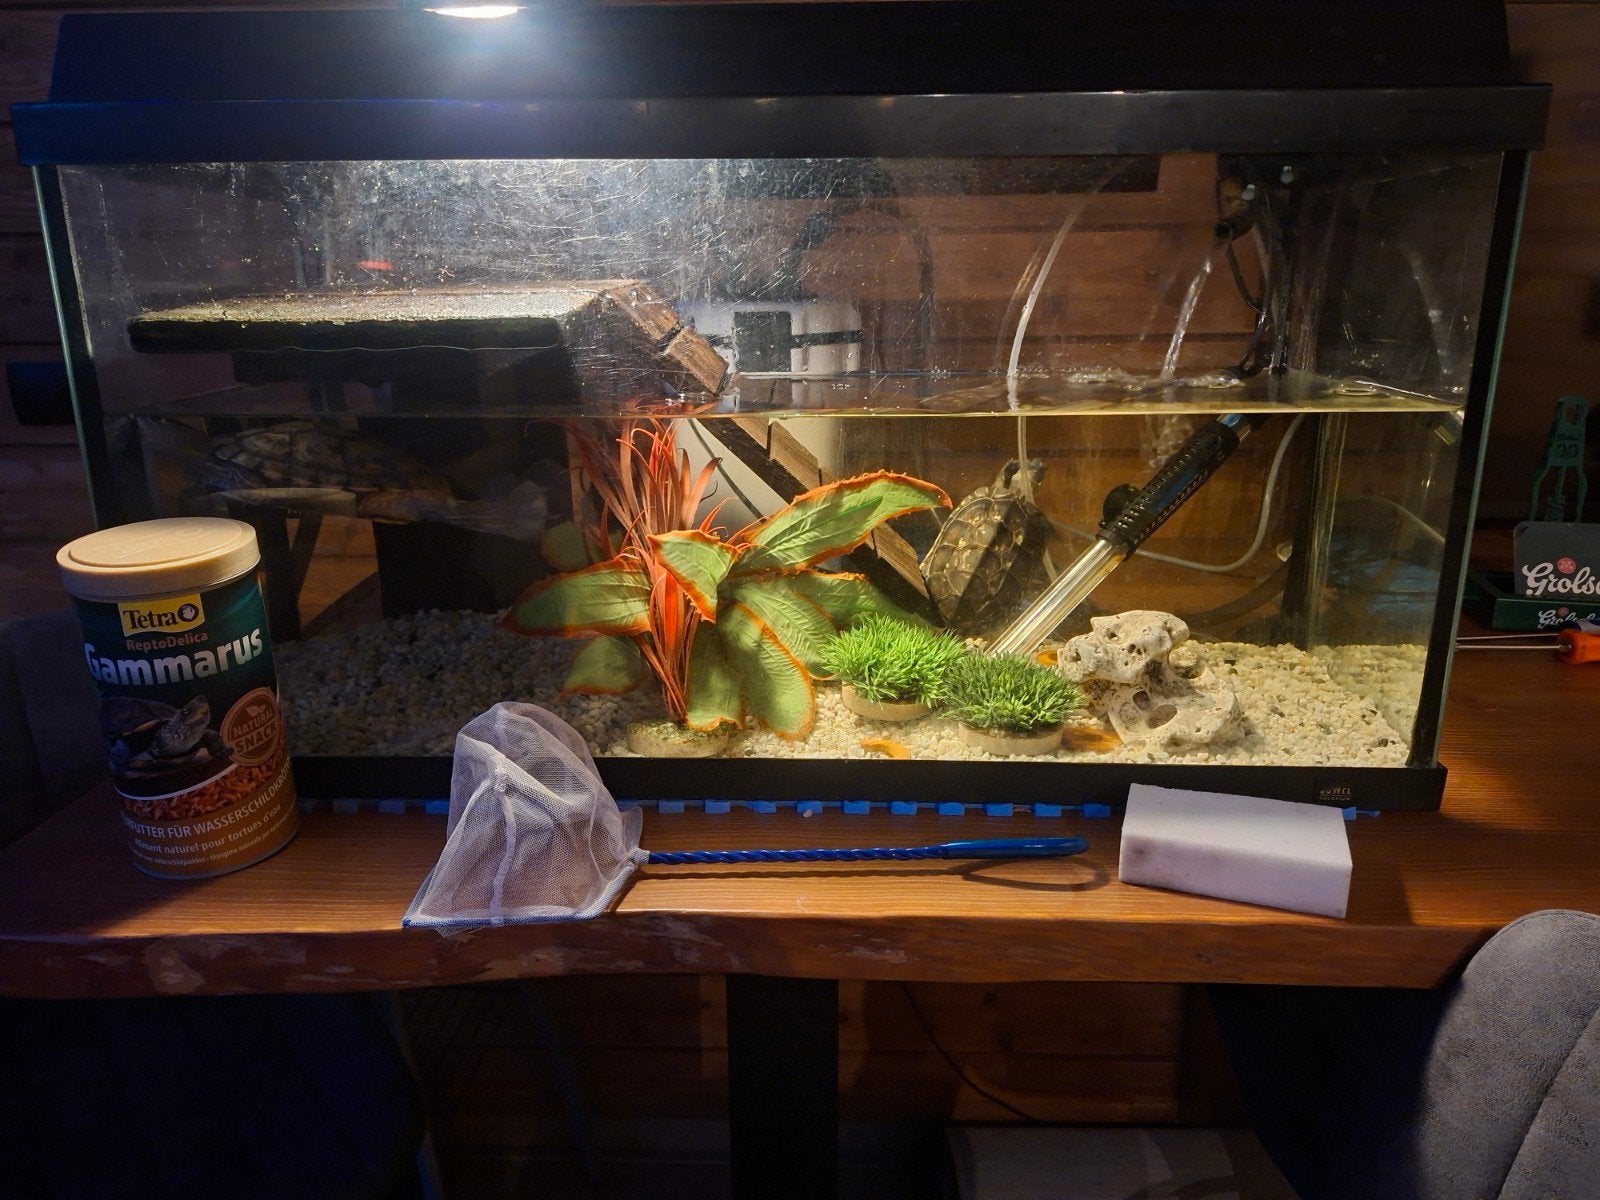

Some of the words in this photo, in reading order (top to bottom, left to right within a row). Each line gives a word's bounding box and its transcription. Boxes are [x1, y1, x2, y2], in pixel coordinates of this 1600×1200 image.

[122, 610, 179, 630] Tetra
[84, 628, 263, 686] Gammarus
[126, 632, 209, 653] ReptoDelica
[233, 709, 274, 738] NATURAL
[235, 723, 276, 754] SNACK
[164, 843, 199, 854] naturel
[201, 837, 226, 852] pour
[228, 821, 263, 842] tortues
[263, 804, 282, 823] d'eau
[167, 824, 192, 838] FÜR
